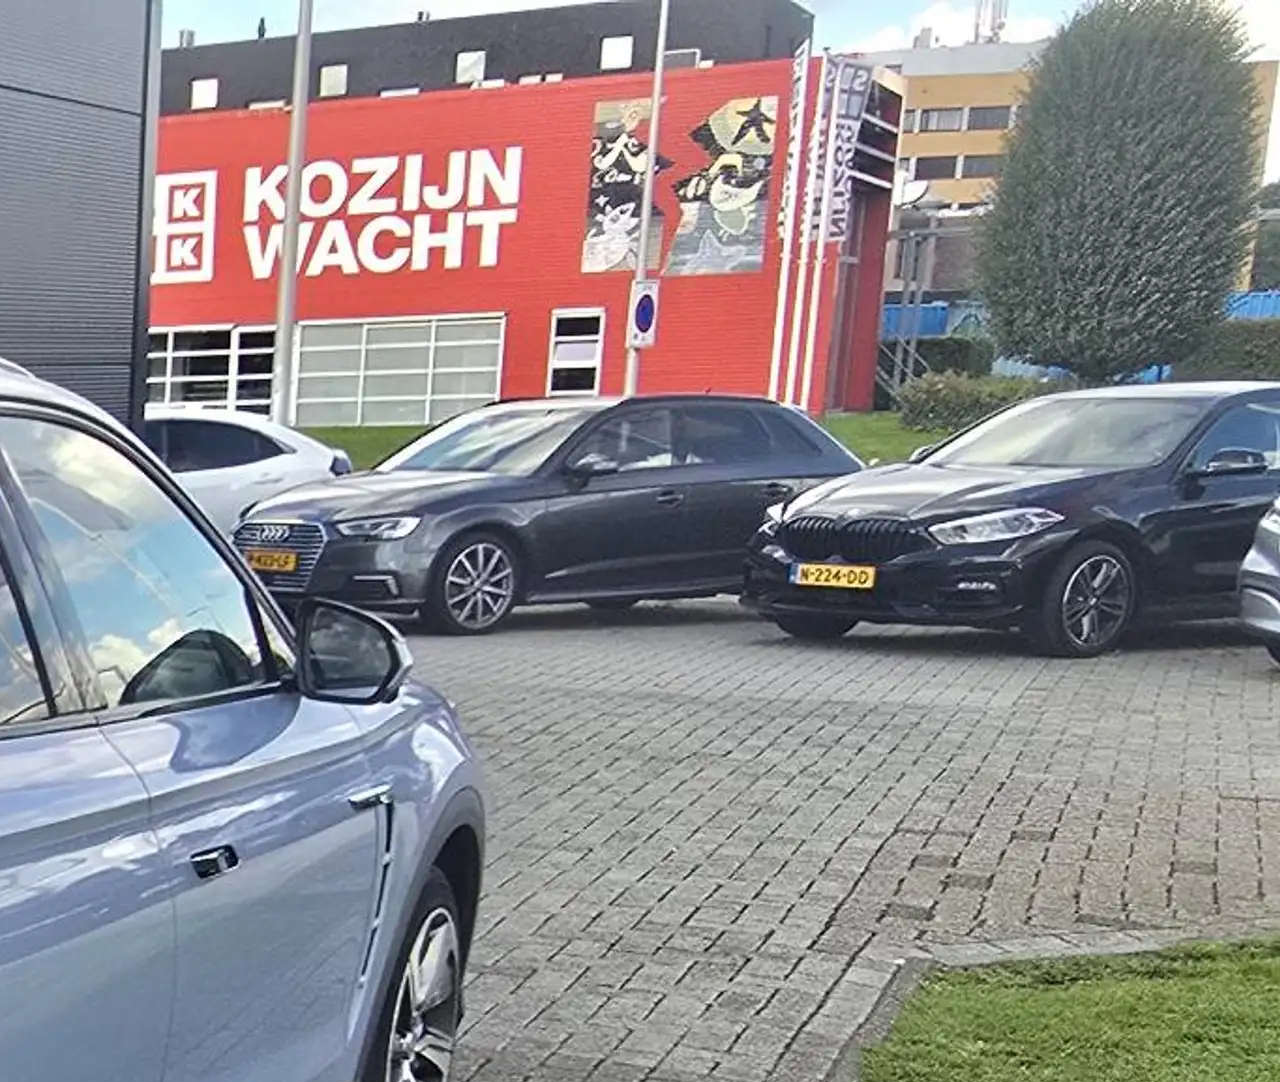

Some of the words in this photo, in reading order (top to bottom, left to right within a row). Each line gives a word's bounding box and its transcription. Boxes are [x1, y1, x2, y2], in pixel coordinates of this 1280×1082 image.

[172, 187, 201, 220] K
[243, 146, 523, 222] KOZIJN
[170, 237, 199, 268] K
[243, 208, 518, 280] WACHT
